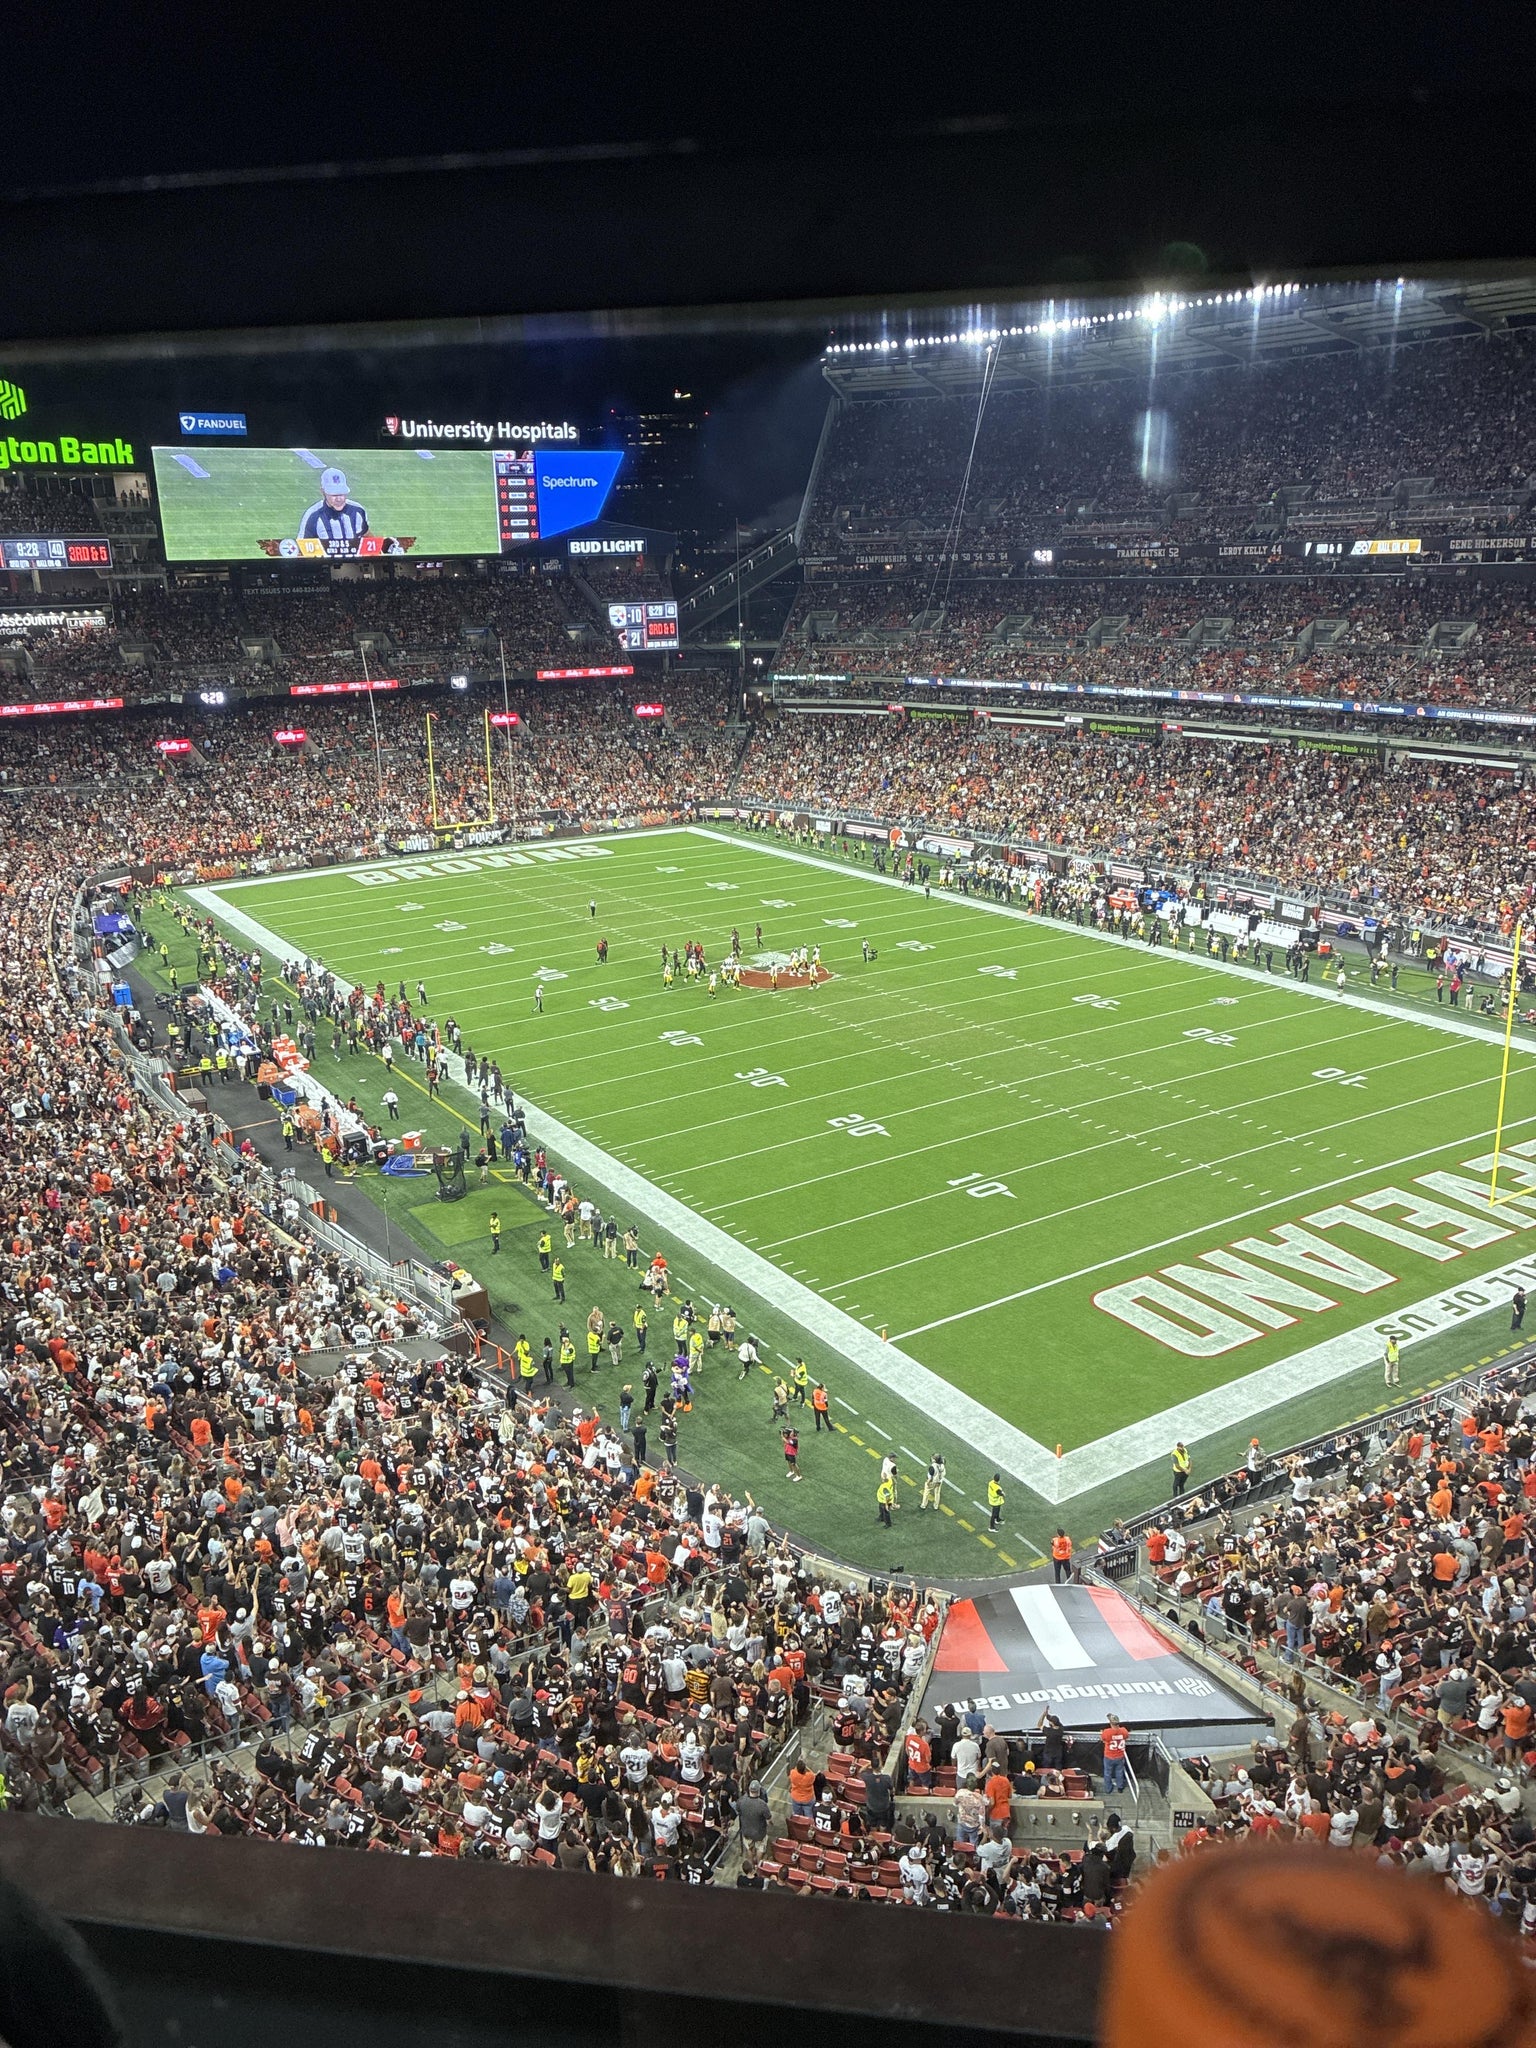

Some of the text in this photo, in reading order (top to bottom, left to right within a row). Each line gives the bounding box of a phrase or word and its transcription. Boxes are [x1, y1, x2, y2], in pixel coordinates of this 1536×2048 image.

[197, 418, 246, 429] FANDUEL
[401, 420, 577, 442] University Hospitals
[59, 436, 135, 465] Bank
[542, 475, 595, 490] Spectrum
[17, 542, 39, 557] 9:28
[52, 543, 62, 556] 40
[305, 541, 313, 552] 10
[367, 541, 376, 551] 21
[570, 540, 644, 554] BUD LIGHT
[1219, 545, 1282, 556] LEROY KELLY 44
[1450, 539, 1473, 550] GENE
[1474, 537, 1526, 549] HICKERSON
[69, 547, 108, 562] 3RD & 5
[856, 555, 907, 563] CHAMPIONSHIPS
[1117, 548, 1179, 558] FRANK GATSKI 52
[631, 609, 642, 623] 10
[631, 632, 641, 646] 21
[452, 677, 466, 688] 40
[1306, 741, 1341, 752] Huntington
[1342, 745, 1358, 753] Bank
[346, 845, 615, 886] BROWNS
[588, 996, 630, 1011] 50
[1071, 993, 1121, 1009] 30
[657, 1030, 701, 1046] 40
[1182, 1028, 1239, 1045] 20
[734, 1068, 785, 1087] 30
[1311, 1067, 1369, 1084] 10
[826, 1113, 885, 1136] 20
[946, 1172, 1008, 1198] 10
[1439, 1290, 1491, 1317] OF
[1374, 1313, 1438, 1341] US
[412, 1474, 426, 1486] 19
[650, 1563, 656, 1572] 7
[153, 1572, 160, 1583] 2
[63, 1582, 75, 1595] 10
[365, 1594, 373, 1609] 6
[826, 1600, 840, 1613] 24
[860, 1650, 868, 1660] 2
[884, 1651, 898, 1662] 29
[623, 1669, 638, 1683] 80
[1012, 1681, 1173, 1706] Huntington
[842, 1724, 855, 1738] 80
[303, 1741, 316, 1758] 31
[1109, 1741, 1125, 1750] 24
[684, 1759, 698, 1769] 24
[815, 1819, 831, 1831] 94
